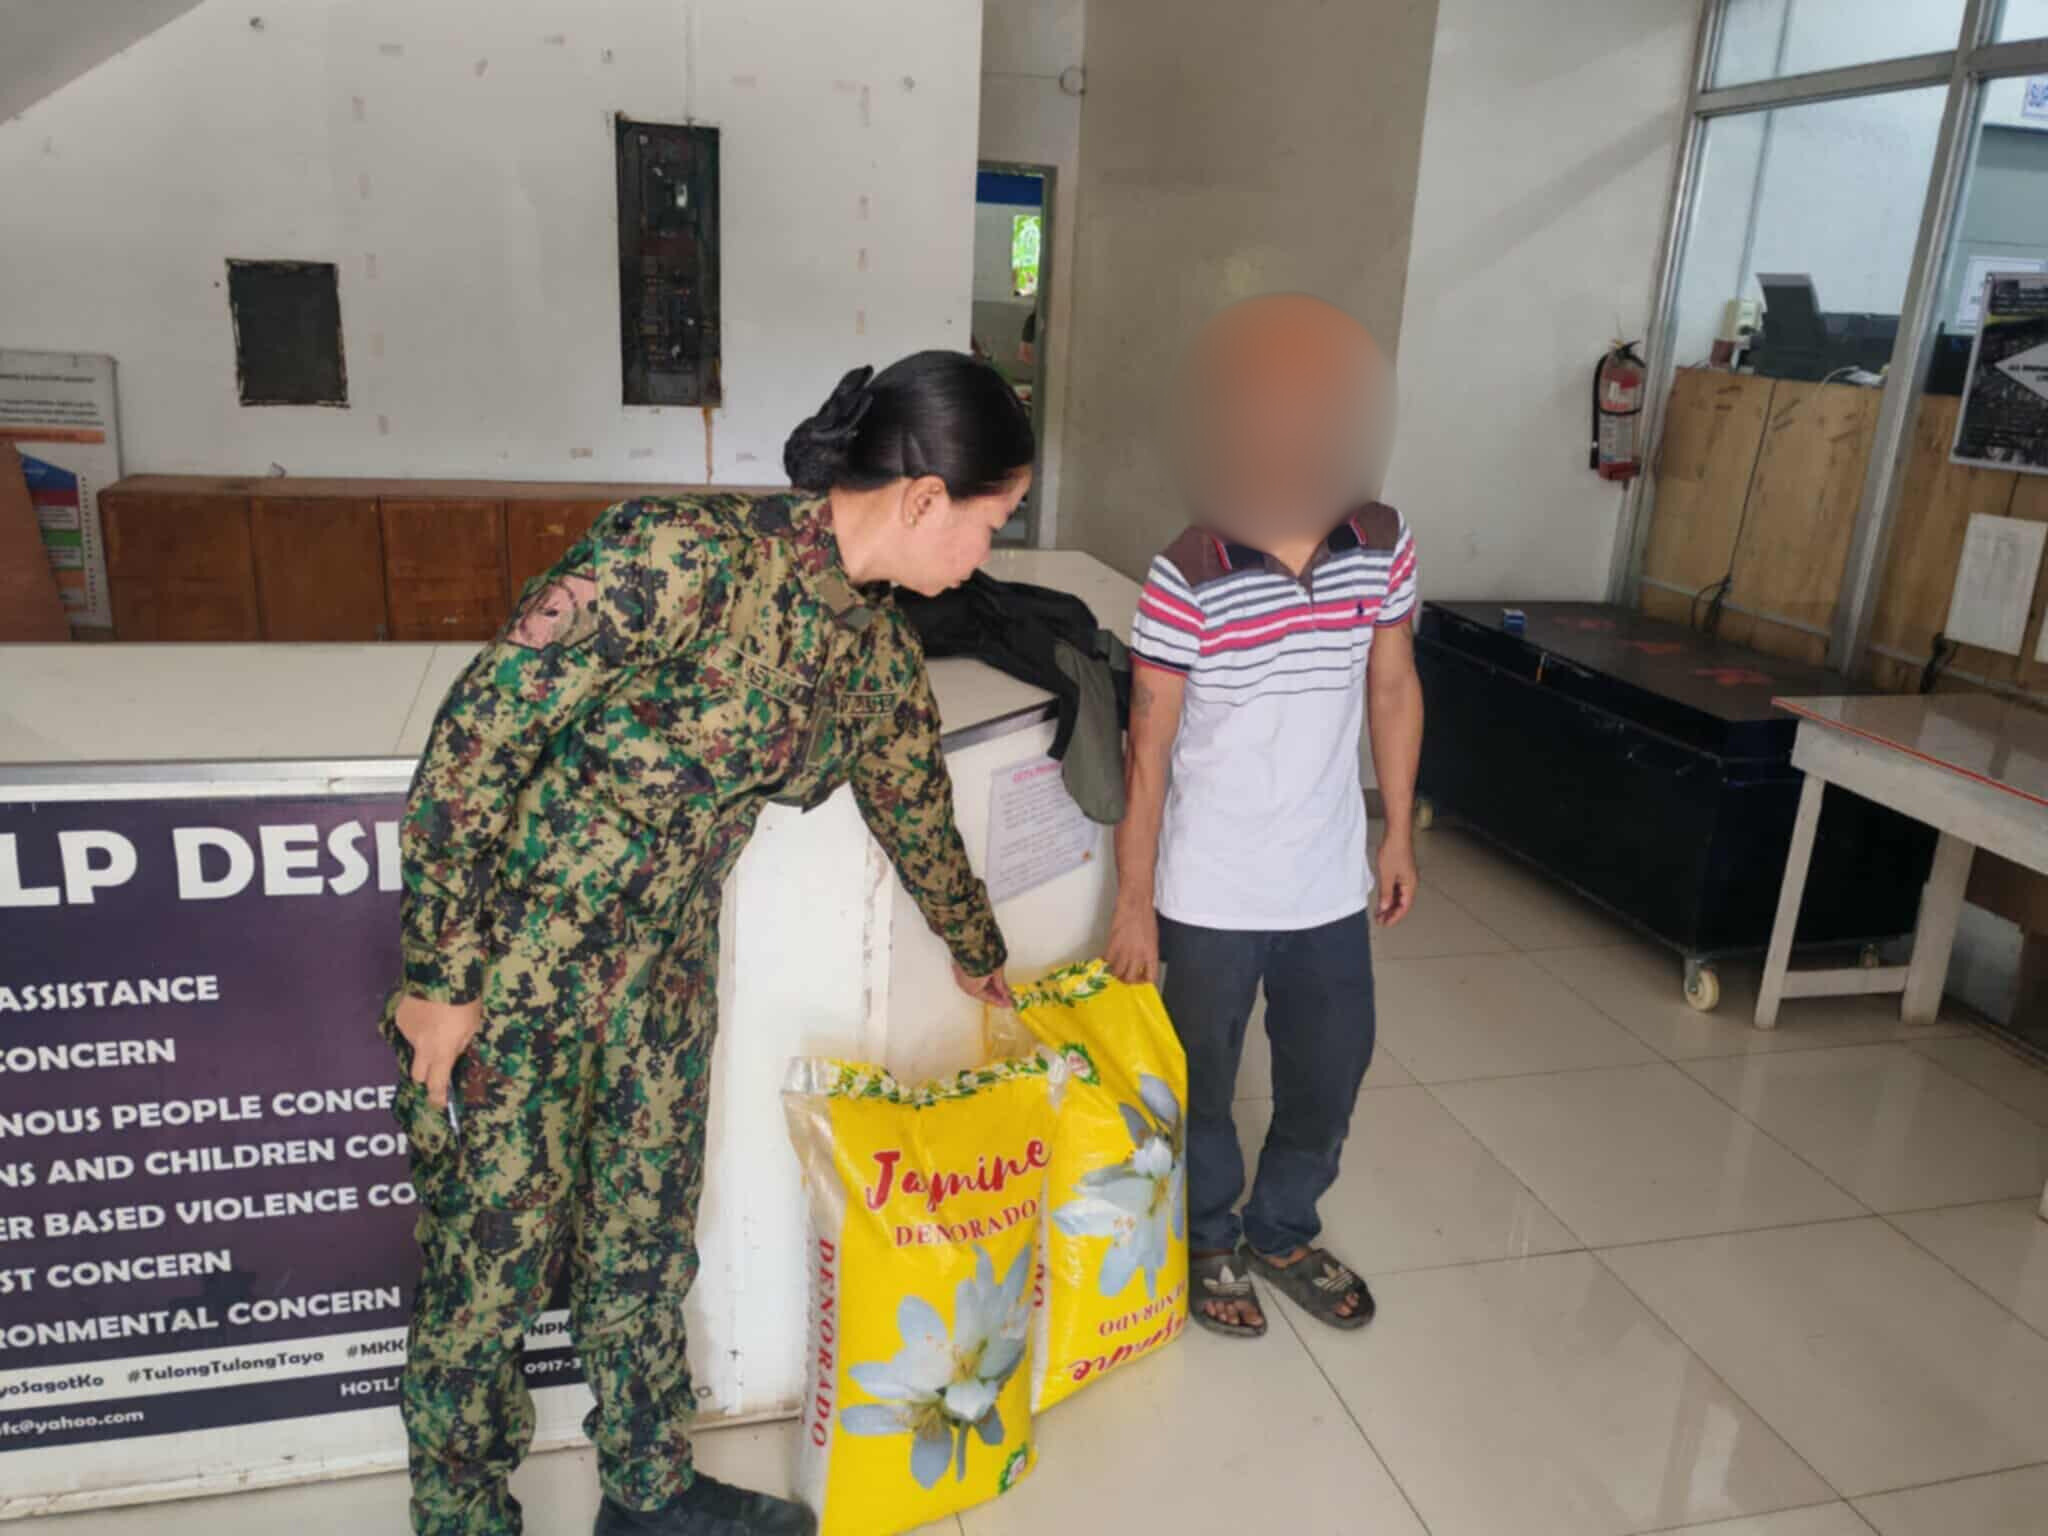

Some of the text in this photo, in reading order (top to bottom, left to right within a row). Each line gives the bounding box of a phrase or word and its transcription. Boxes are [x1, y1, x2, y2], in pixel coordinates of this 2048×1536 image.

[0, 830, 138, 907] LP
[0, 974, 219, 1013] ASSISTANCE
[0, 1038, 176, 1073] ONCERN
[0, 1107, 101, 1138] NOUS
[112, 1095, 262, 1129] PEOPLE
[47, 1155, 135, 1184] AND
[145, 1138, 335, 1175] CHILDREN
[43, 1205, 166, 1238] BASED
[175, 1186, 359, 1224] VIOLENCE
[896, 1200, 1038, 1247] DENORADO
[47, 1250, 231, 1288] CONCERN
[227, 1286, 400, 1325] CONCERN
[811, 1237, 835, 1447] DENORADO
[127, 1352, 325, 1383] #TulongTulongTayo
